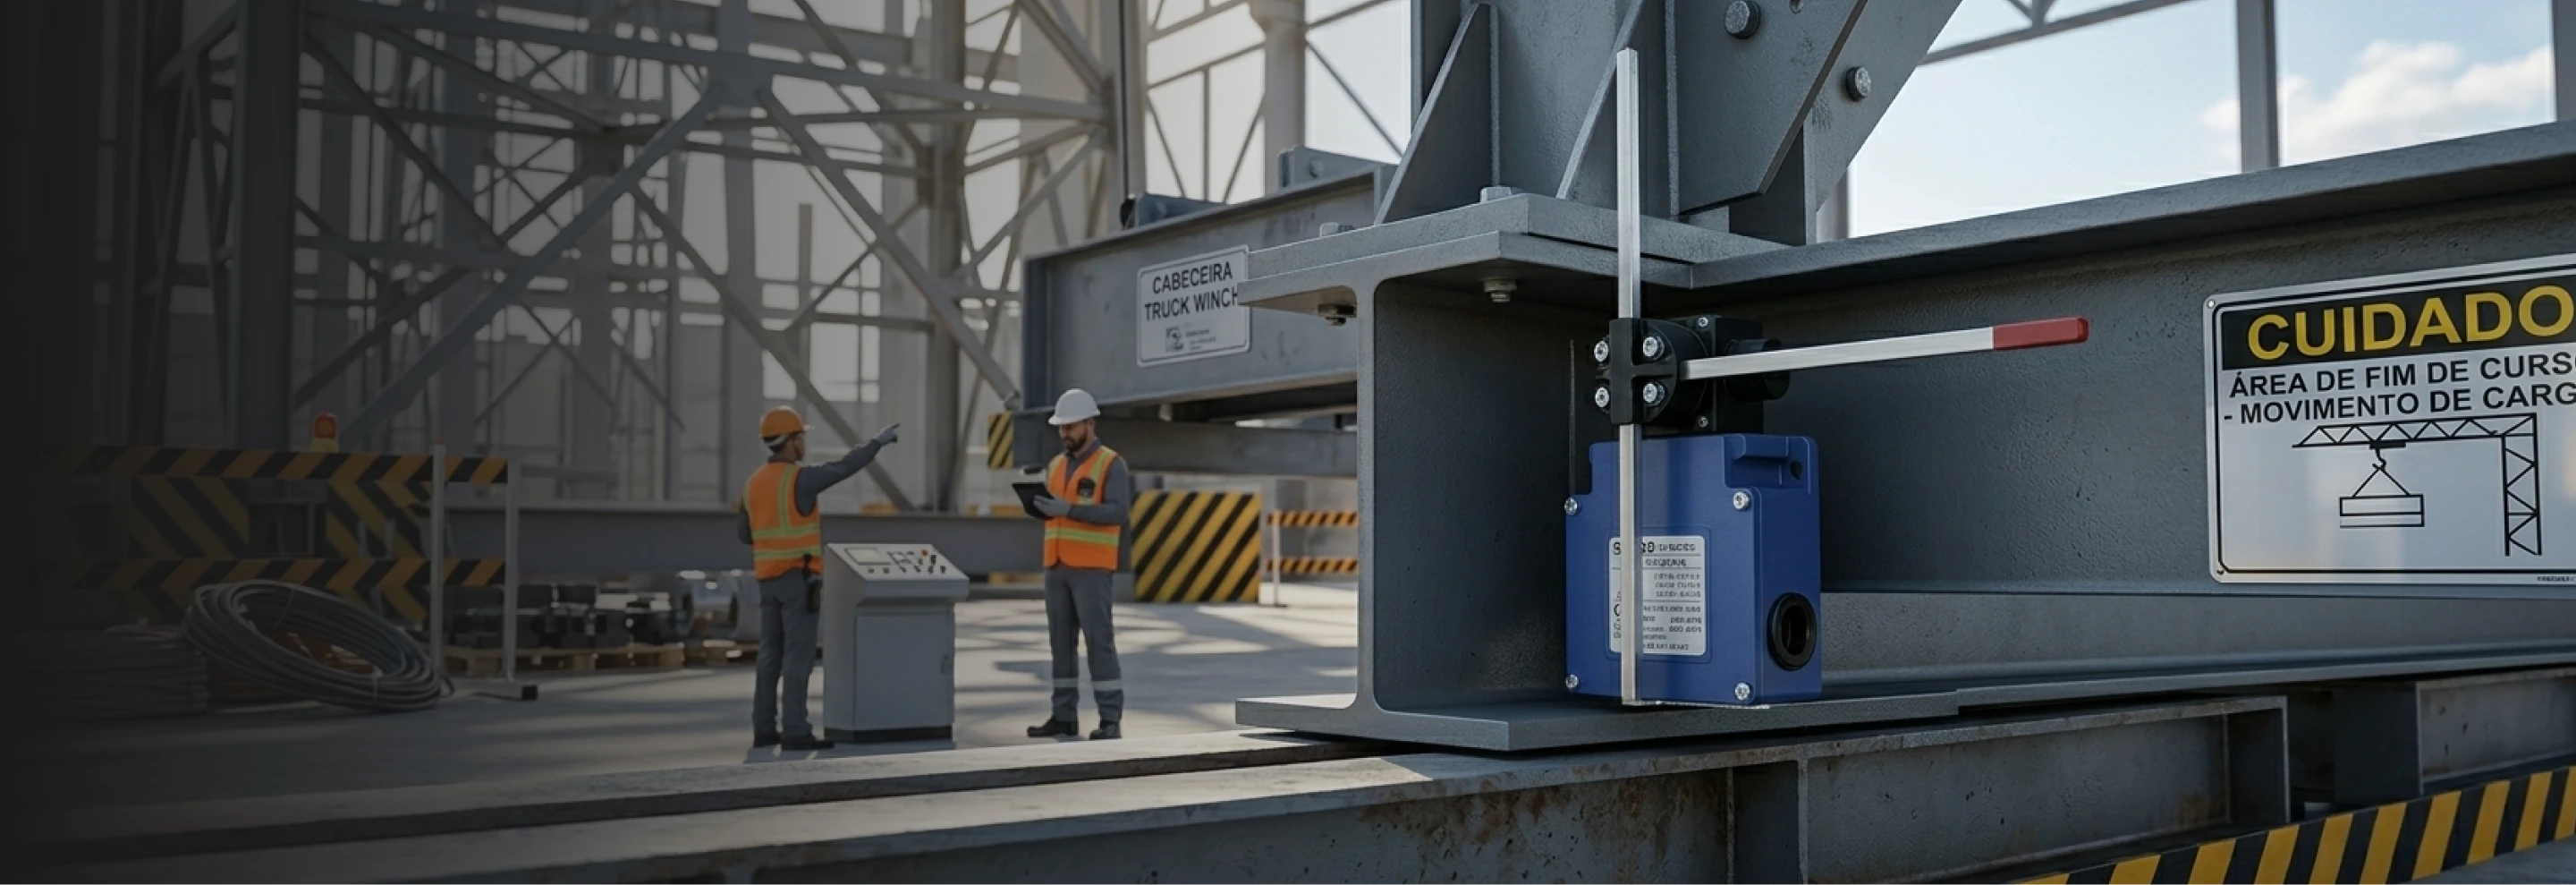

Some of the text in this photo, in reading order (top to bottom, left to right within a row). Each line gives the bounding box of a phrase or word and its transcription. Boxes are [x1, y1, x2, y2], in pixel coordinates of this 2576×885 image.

[1152, 261, 1233, 294] CABECEIRA
[1144, 296, 1191, 321] TRUCK
[2247, 285, 2575, 360] CUIDADO
[2230, 351, 2576, 398] ÁREA DE FIM DE CURS
[2241, 393, 2419, 424] MOVIMENTO
[2430, 388, 2472, 413] DE
